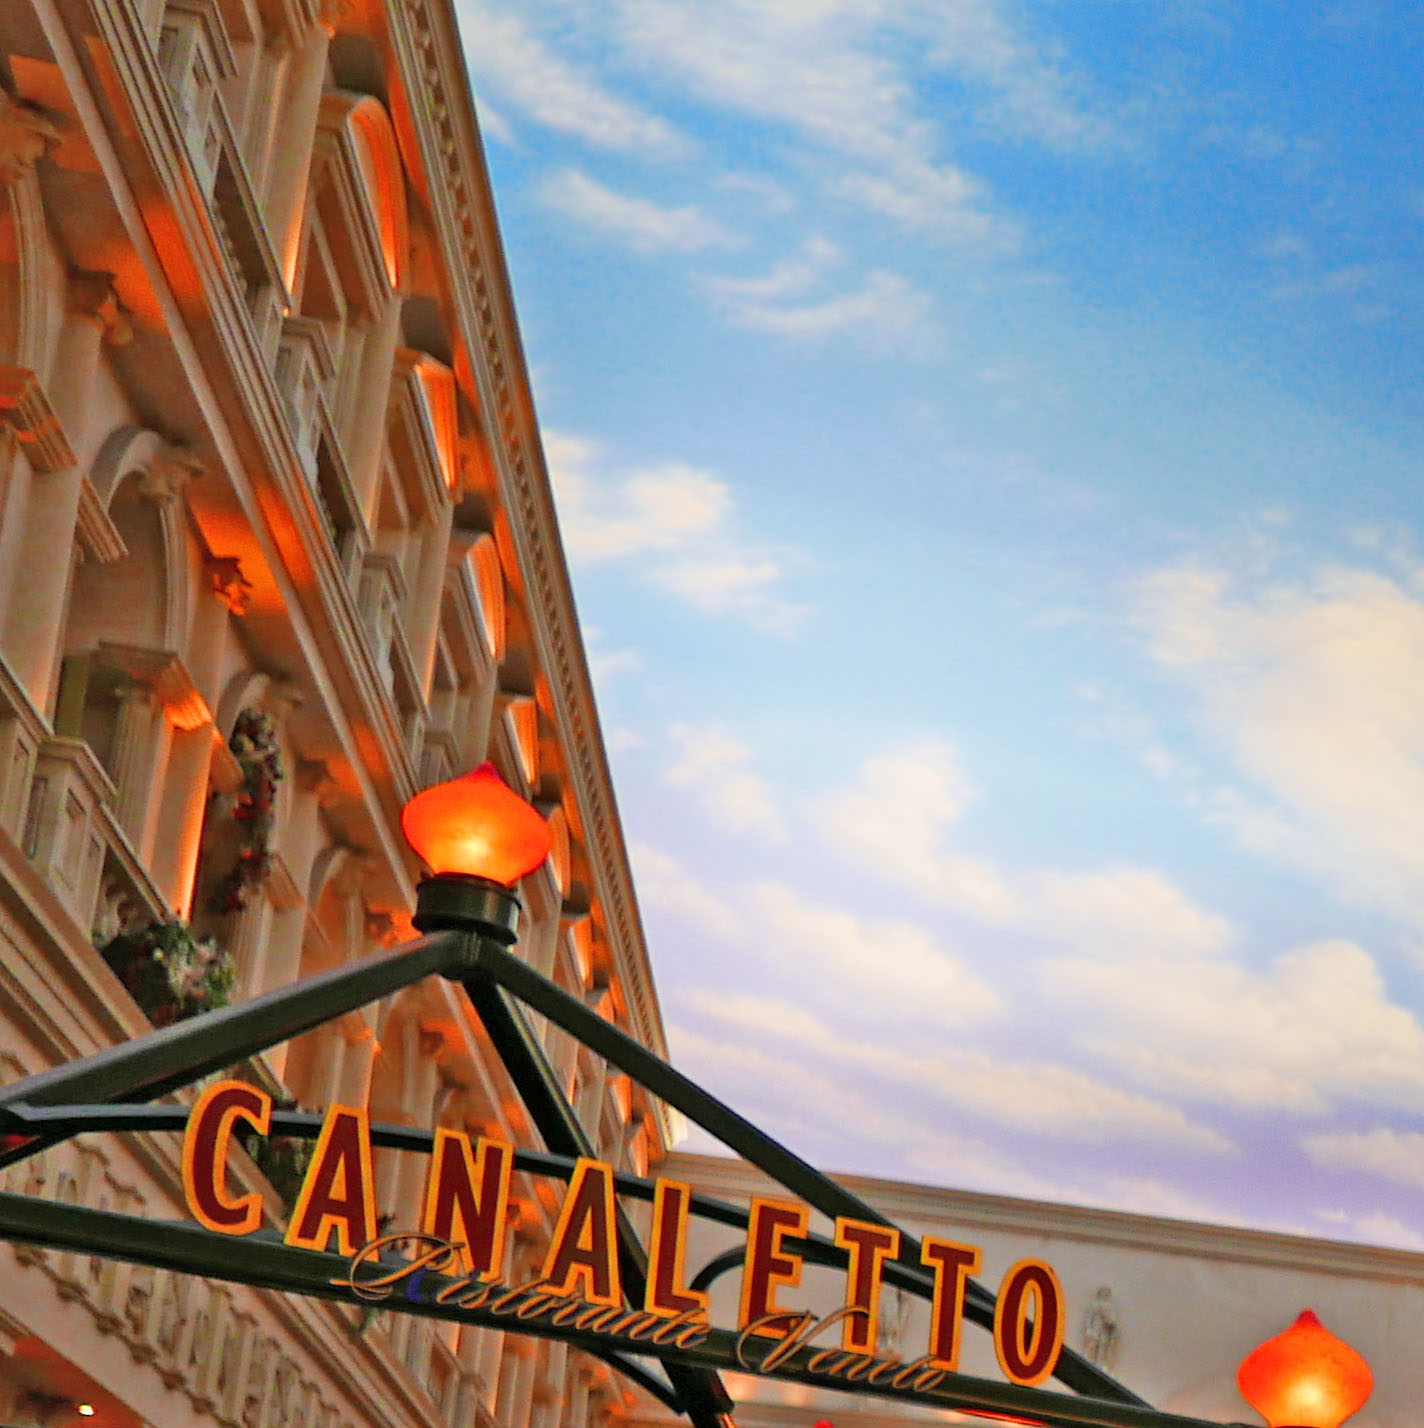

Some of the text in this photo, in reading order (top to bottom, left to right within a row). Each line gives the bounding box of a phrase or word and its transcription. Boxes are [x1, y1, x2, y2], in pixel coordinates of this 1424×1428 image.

[182, 1079, 1067, 1387] CANALETTO
[329, 1231, 964, 1391] Ristorante Veneto
